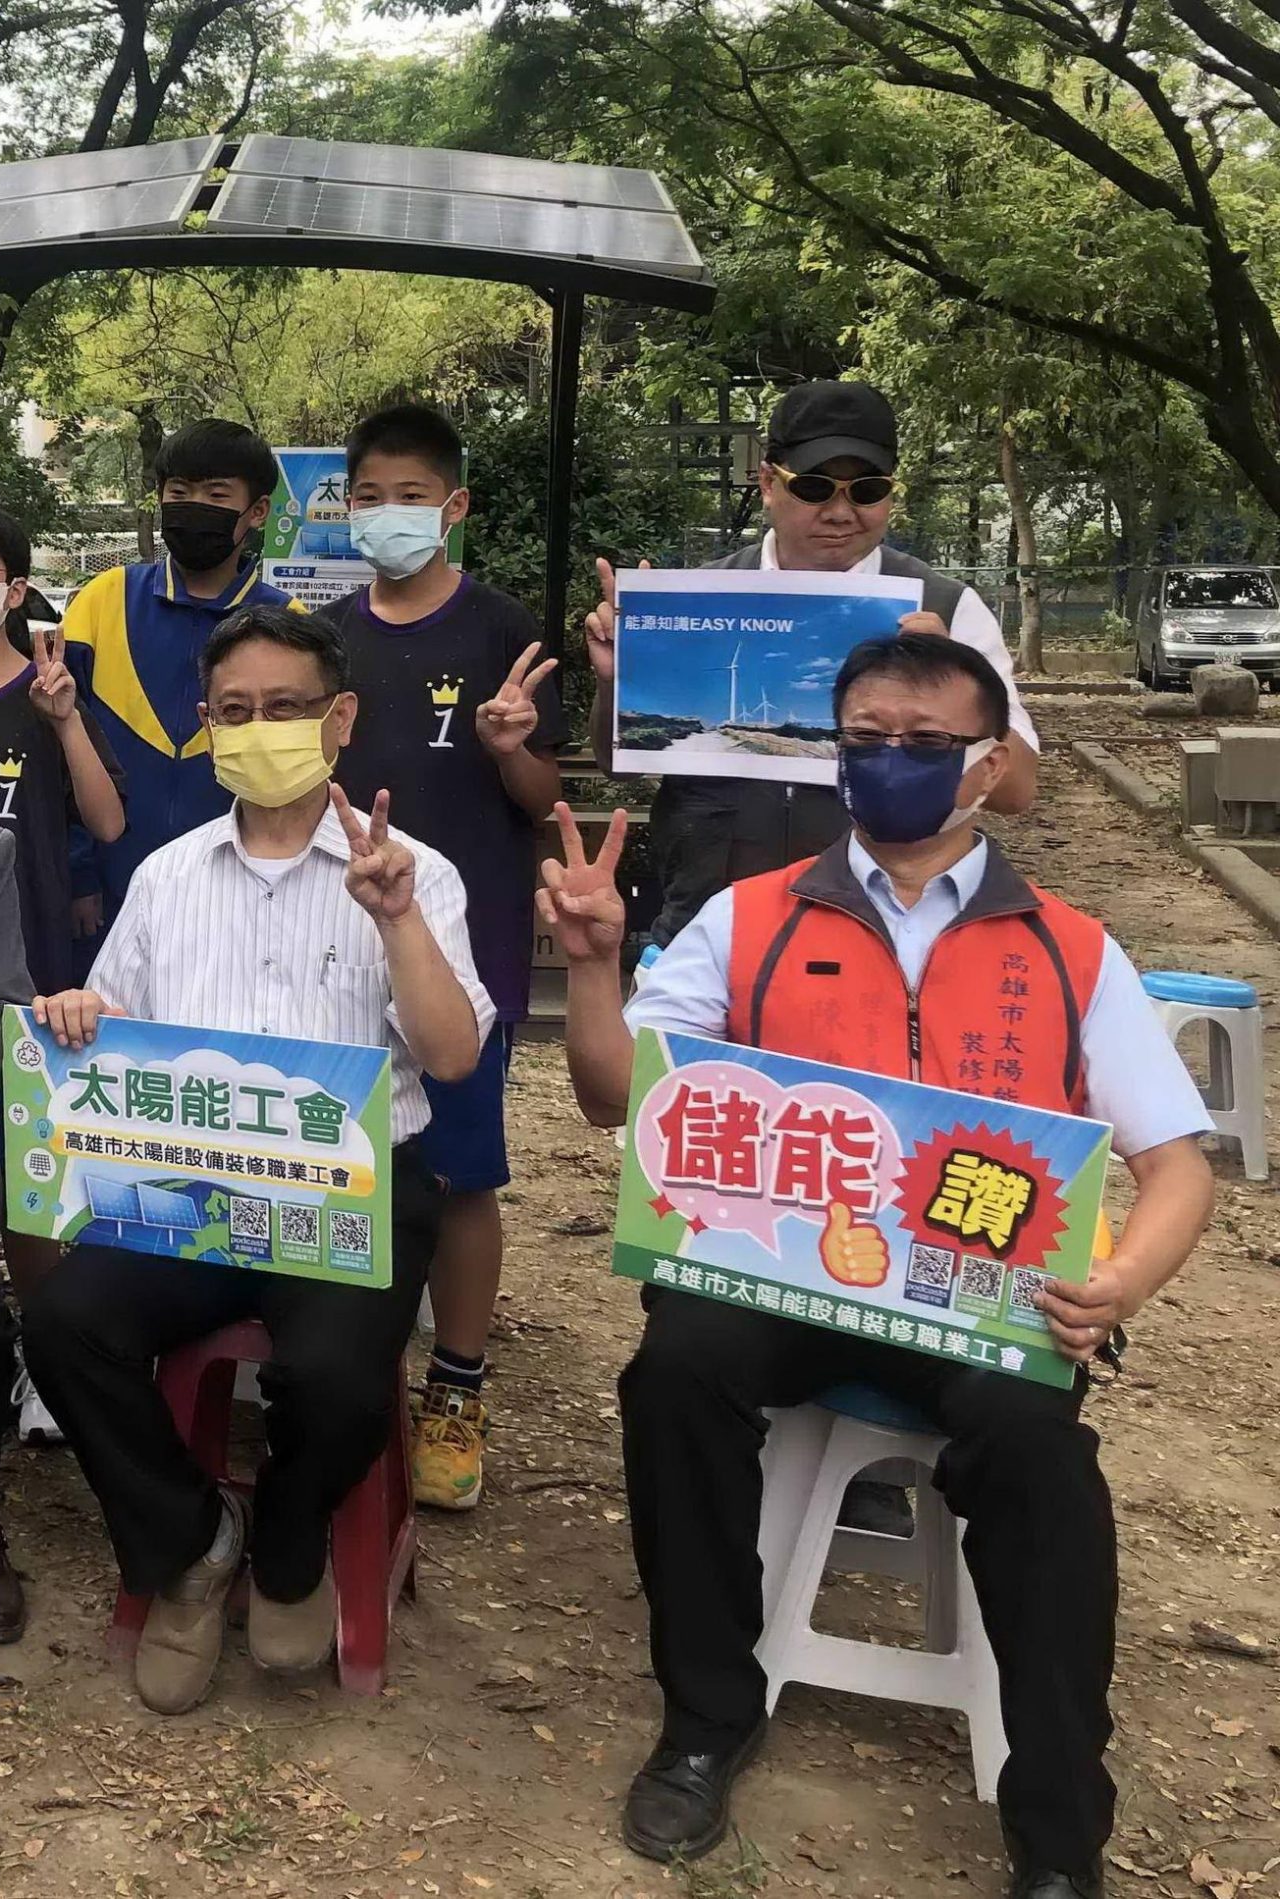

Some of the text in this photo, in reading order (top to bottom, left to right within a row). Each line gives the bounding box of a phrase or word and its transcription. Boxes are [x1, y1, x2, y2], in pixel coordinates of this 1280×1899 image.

[740, 618, 794, 633] KNOW
[427, 707, 456, 749] 1
[68, 1062, 348, 1146] 太陽能工會
[64, 1130, 352, 1188] 高雄市太陽能設備裝修職業工會
[657, 1083, 1031, 1249] 儲能 讚
[652, 1257, 1026, 1371] 高雄市太陽能設備裝修職業工會
